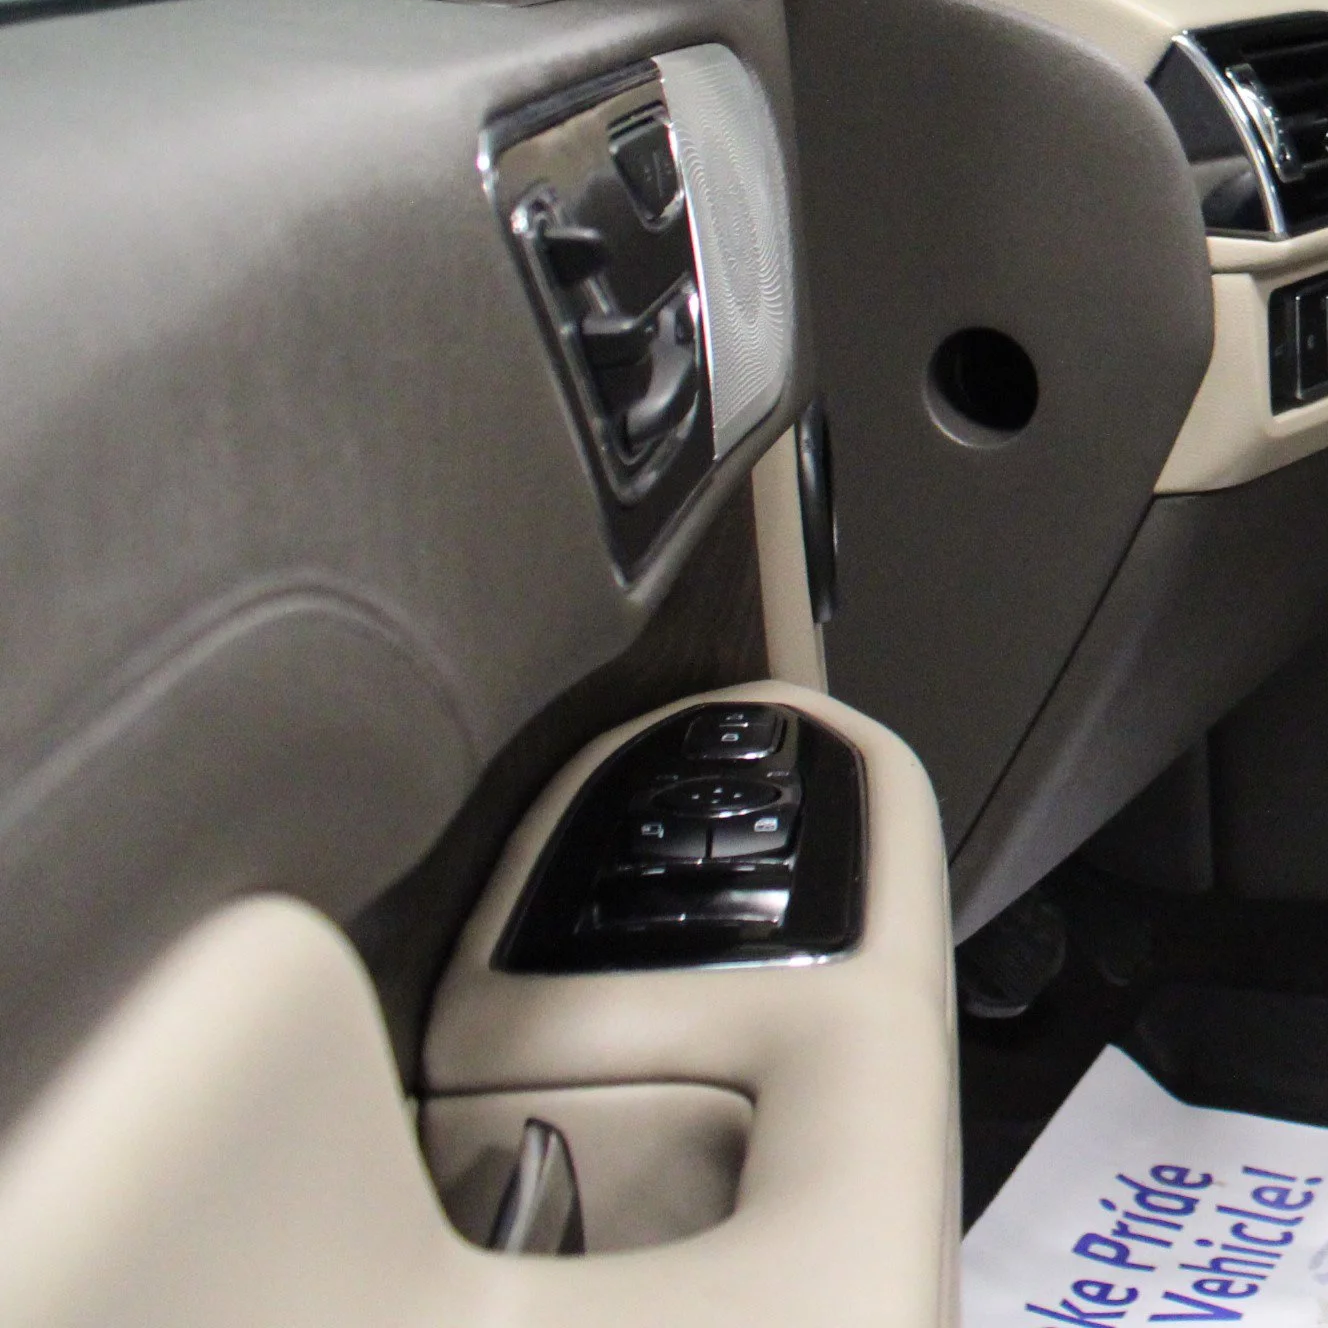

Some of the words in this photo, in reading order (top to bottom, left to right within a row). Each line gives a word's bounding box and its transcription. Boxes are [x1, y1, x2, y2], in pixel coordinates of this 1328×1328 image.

[1071, 1163, 1214, 1272] Pride
[1147, 1165, 1323, 1322] Vehicle!
[1025, 1278, 1139, 1328] ke
